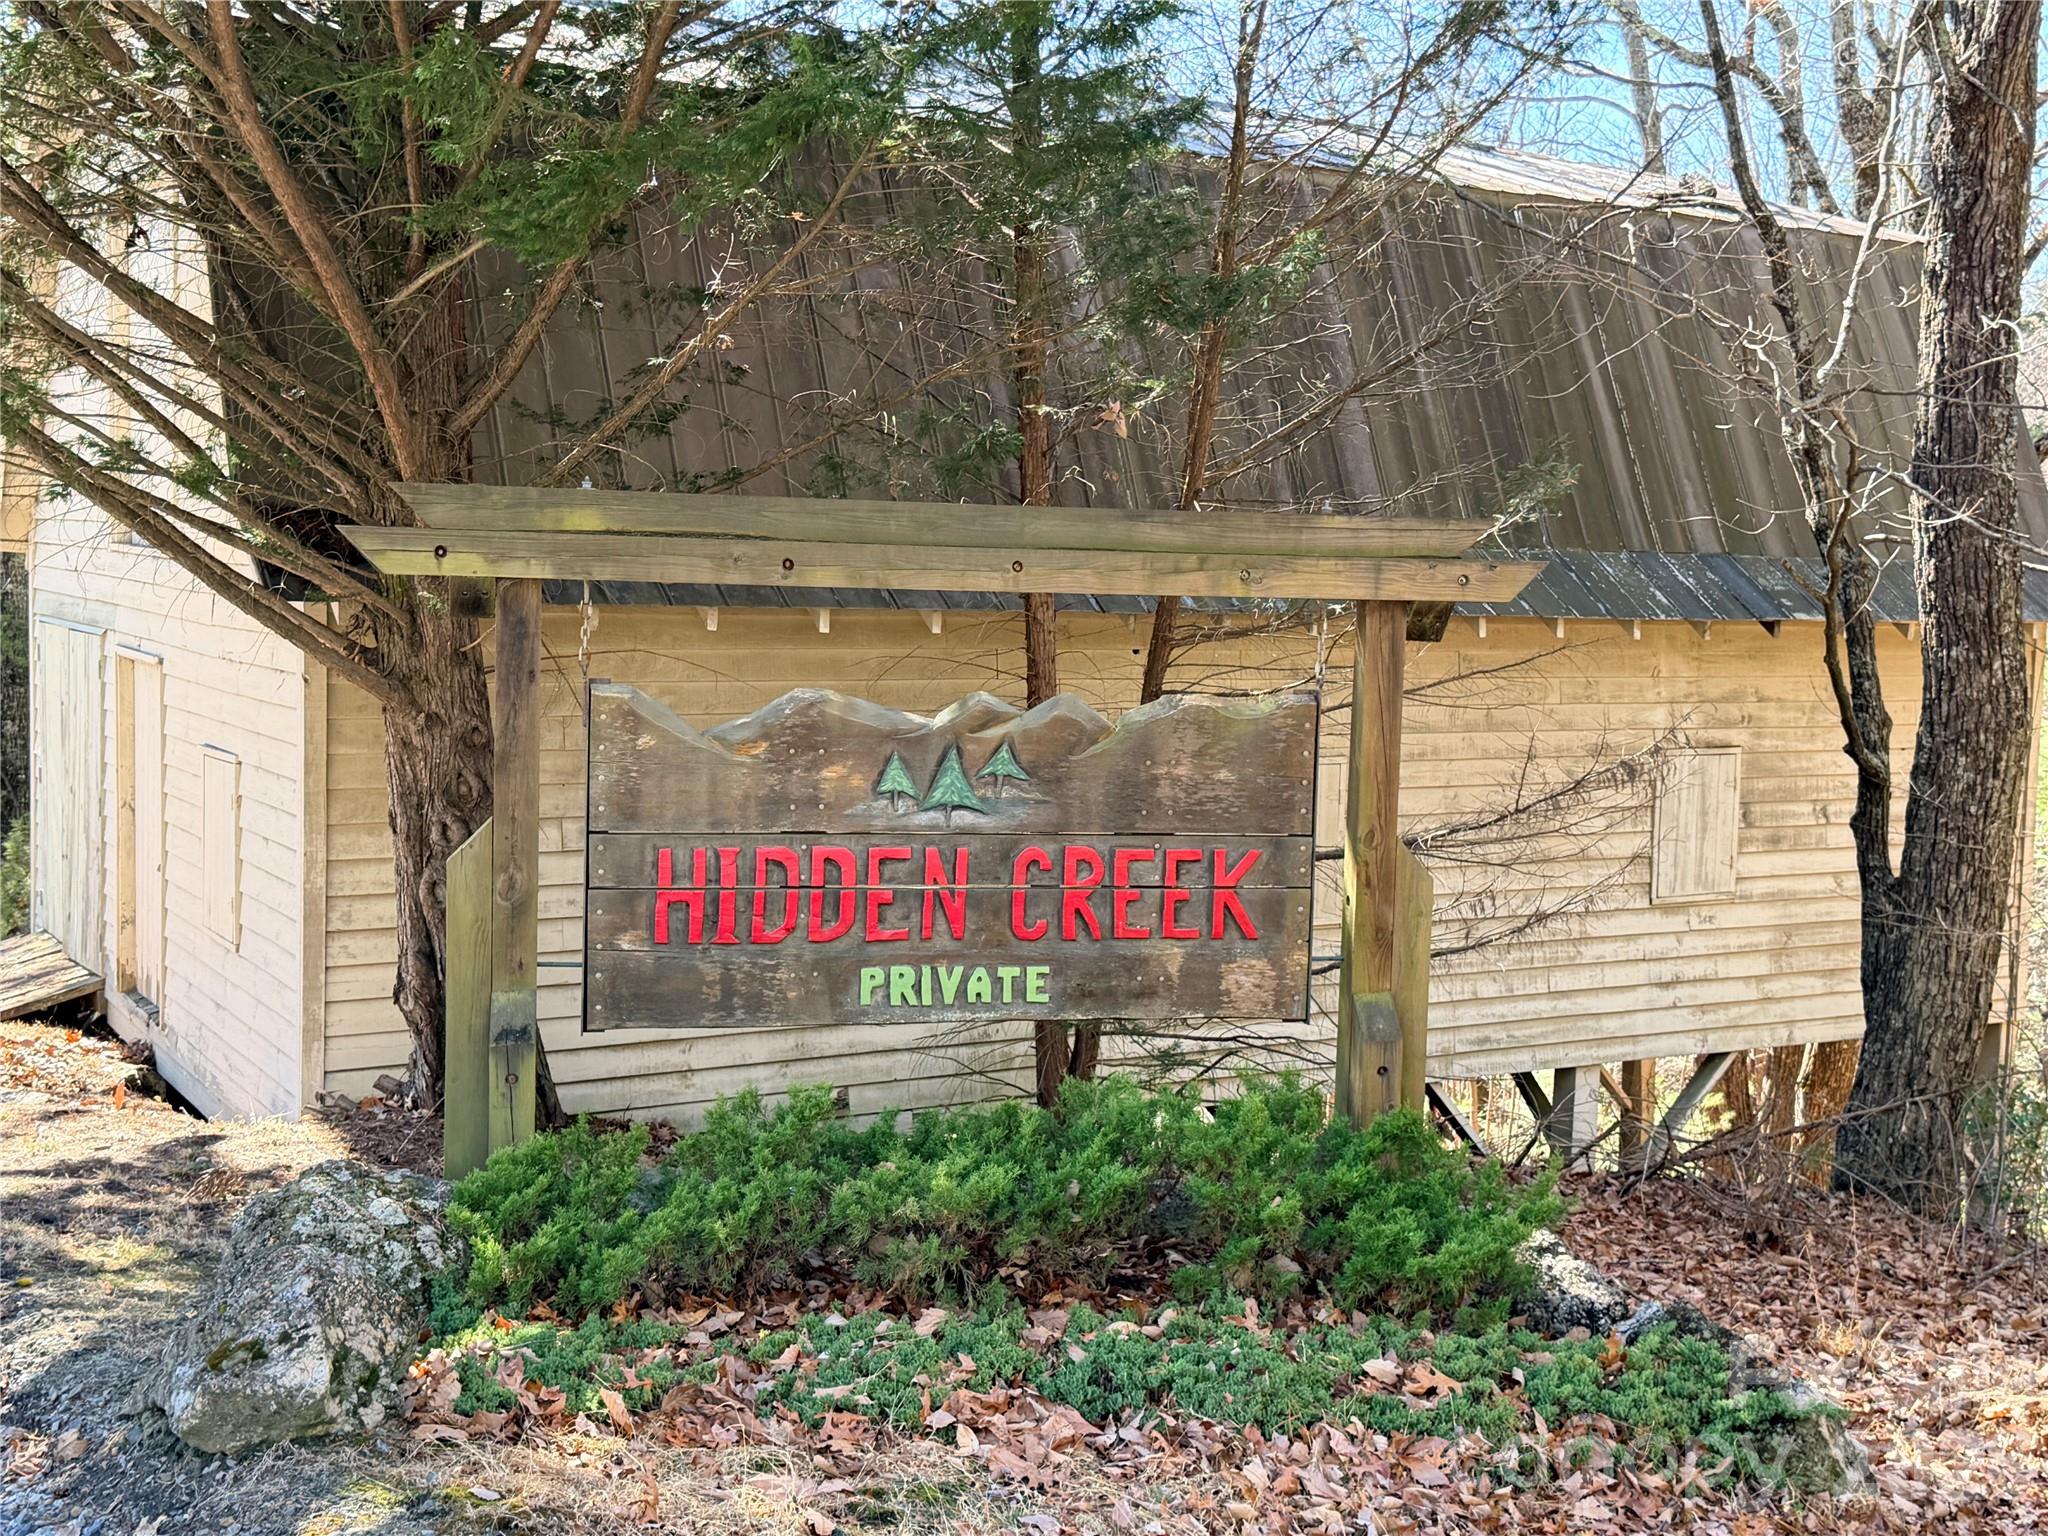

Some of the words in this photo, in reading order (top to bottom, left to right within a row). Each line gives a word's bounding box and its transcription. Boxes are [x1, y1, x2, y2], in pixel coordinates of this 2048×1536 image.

[654, 846, 970, 945] HIDDEN
[1011, 845, 1263, 941] CREEK
[859, 966, 1050, 1006] PRIVATE
